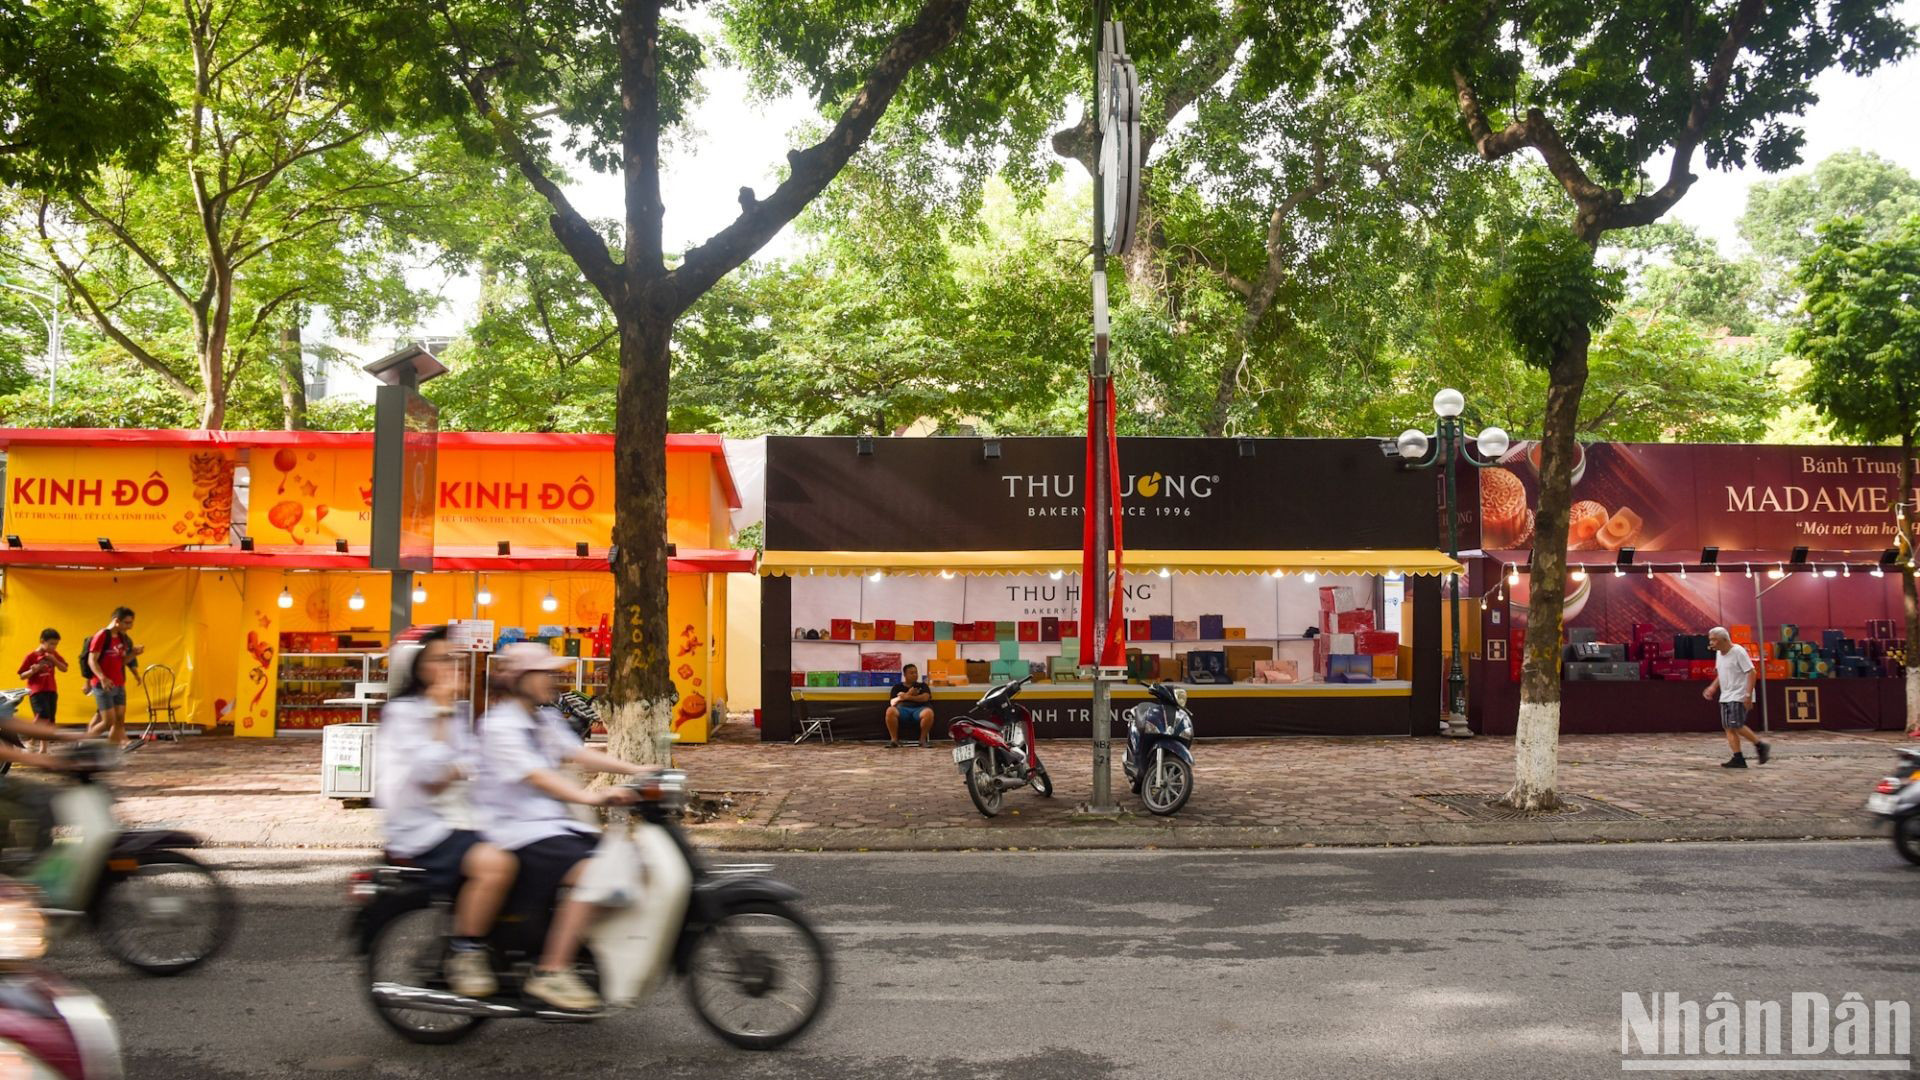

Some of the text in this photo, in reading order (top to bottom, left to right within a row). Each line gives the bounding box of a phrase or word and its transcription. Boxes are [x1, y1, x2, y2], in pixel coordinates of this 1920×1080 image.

[1801, 456, 1848, 474] Bánh
[13, 470, 169, 506] KINH ĐÔ
[440, 475, 594, 511] KINH ĐÔ
[1002, 475, 1074, 497] THU
[1726, 486, 1890, 512] MADAME
[1156, 507, 1191, 517] 1996
[1832, 522, 1852, 535] nét
[1006, 586, 1056, 601] THU
